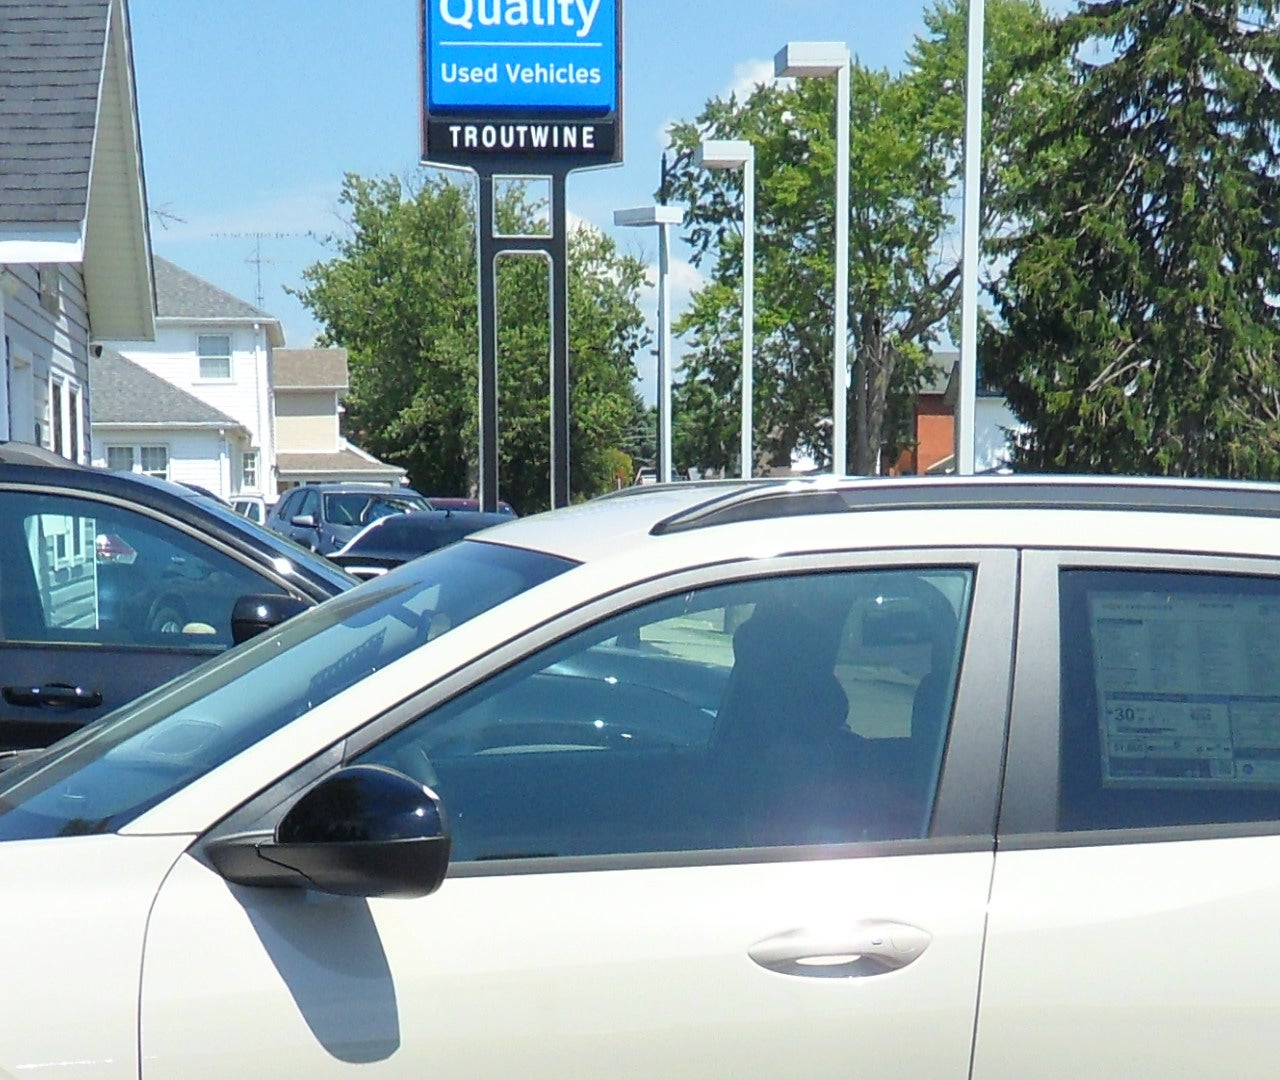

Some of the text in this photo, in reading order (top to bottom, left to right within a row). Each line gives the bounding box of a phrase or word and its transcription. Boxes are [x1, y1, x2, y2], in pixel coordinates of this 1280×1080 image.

[439, 0, 601, 37] Quality
[441, 63, 602, 84] Used Vehicles
[449, 125, 595, 149] TROUTWINE
